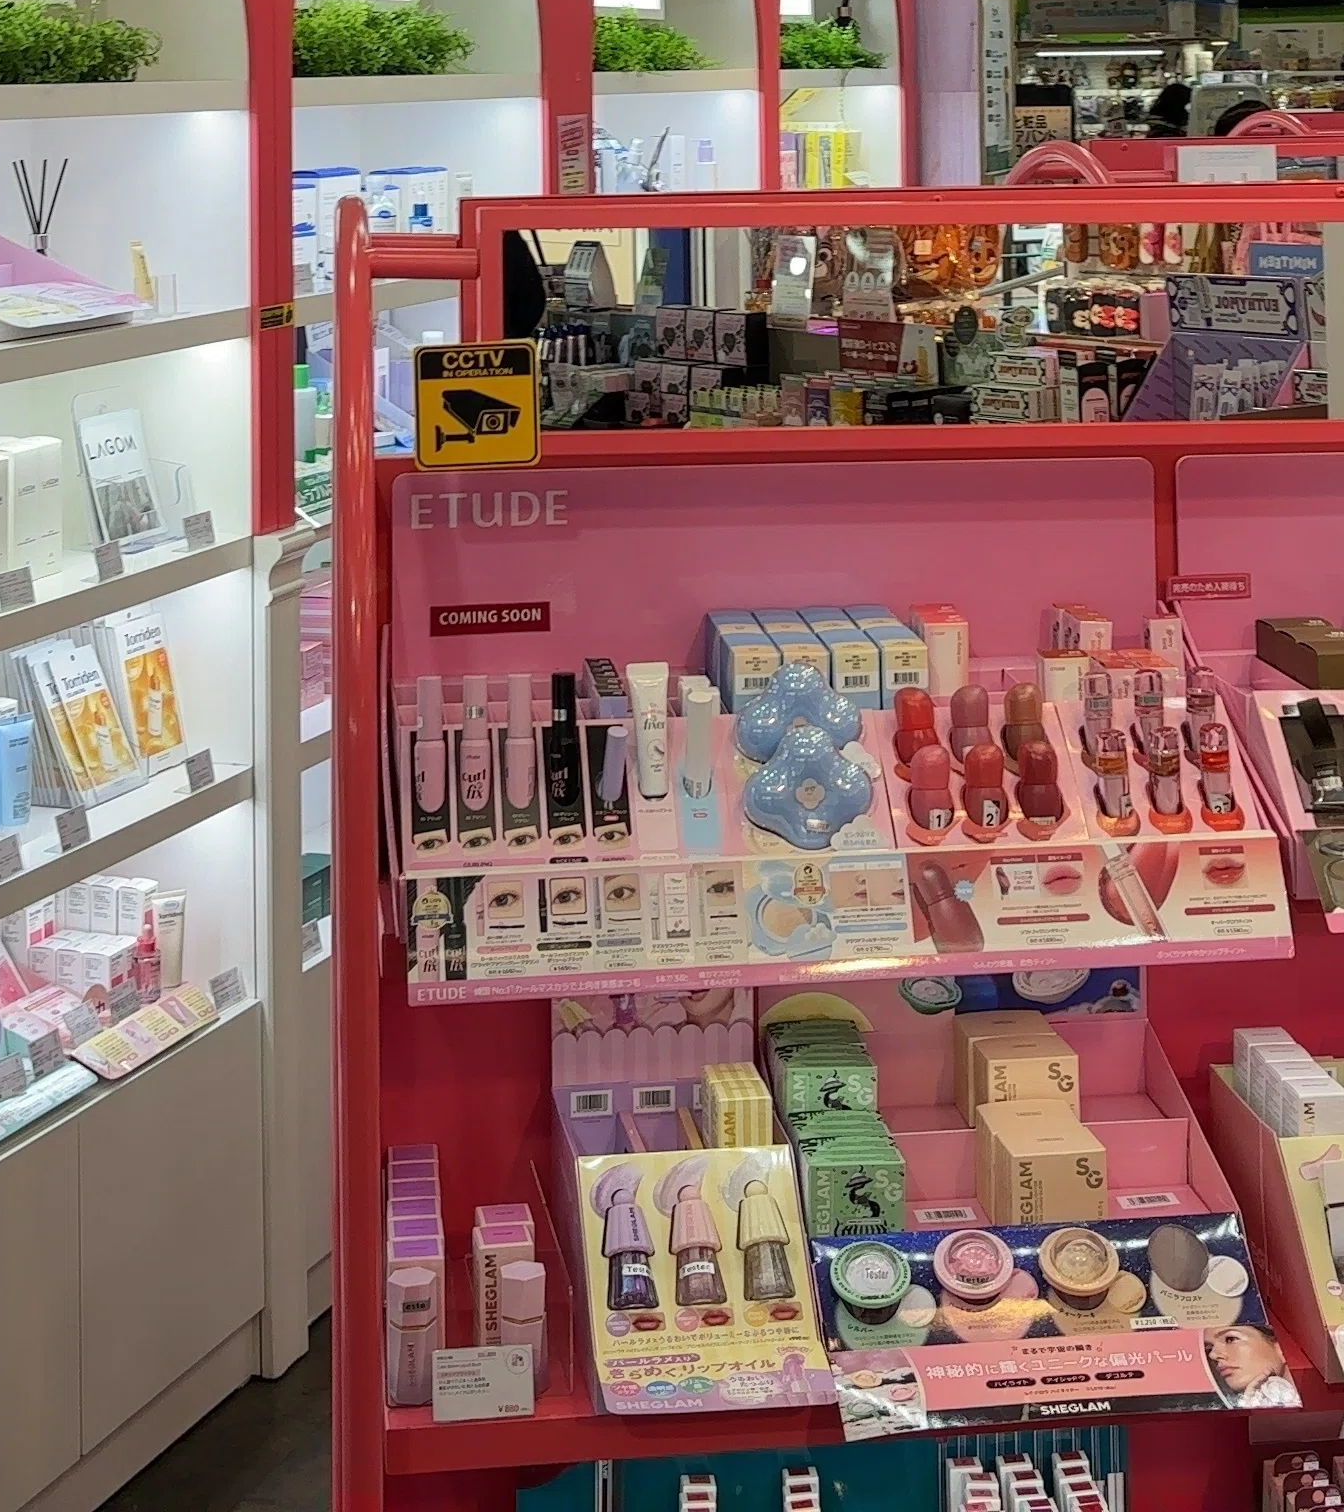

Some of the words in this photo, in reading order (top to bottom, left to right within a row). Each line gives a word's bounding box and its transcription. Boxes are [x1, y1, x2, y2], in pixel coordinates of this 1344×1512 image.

[442, 349, 505, 370] CCTV
[442, 370, 453, 378] IN
[454, 367, 514, 377] OPERATION
[86, 433, 138, 461] LAGOM
[410, 489, 569, 530] ETUDE
[439, 609, 498, 626] COMING
[501, 608, 542, 623] SOON
[61, 669, 101, 691] Torriden
[462, 768, 487, 784] curl
[466, 785, 484, 800] fix
[934, 813, 943, 828] 1
[985, 812, 995, 827] 2
[416, 986, 468, 1002] ETUDE
[1047, 1062, 1075, 1093] SG
[847, 1073, 874, 1106] SG
[1075, 1157, 1104, 1189] SG
[874, 1168, 904, 1202] SG
[864, 1267, 890, 1281] Tester
[485, 1252, 498, 1332] SHEGLAM
[925, 1349, 1194, 1381] 神秘的に輝くユニークな偏光パール
[616, 1397, 704, 1411] SHEGLAM
[1040, 1400, 1112, 1416] SHEGLAM
